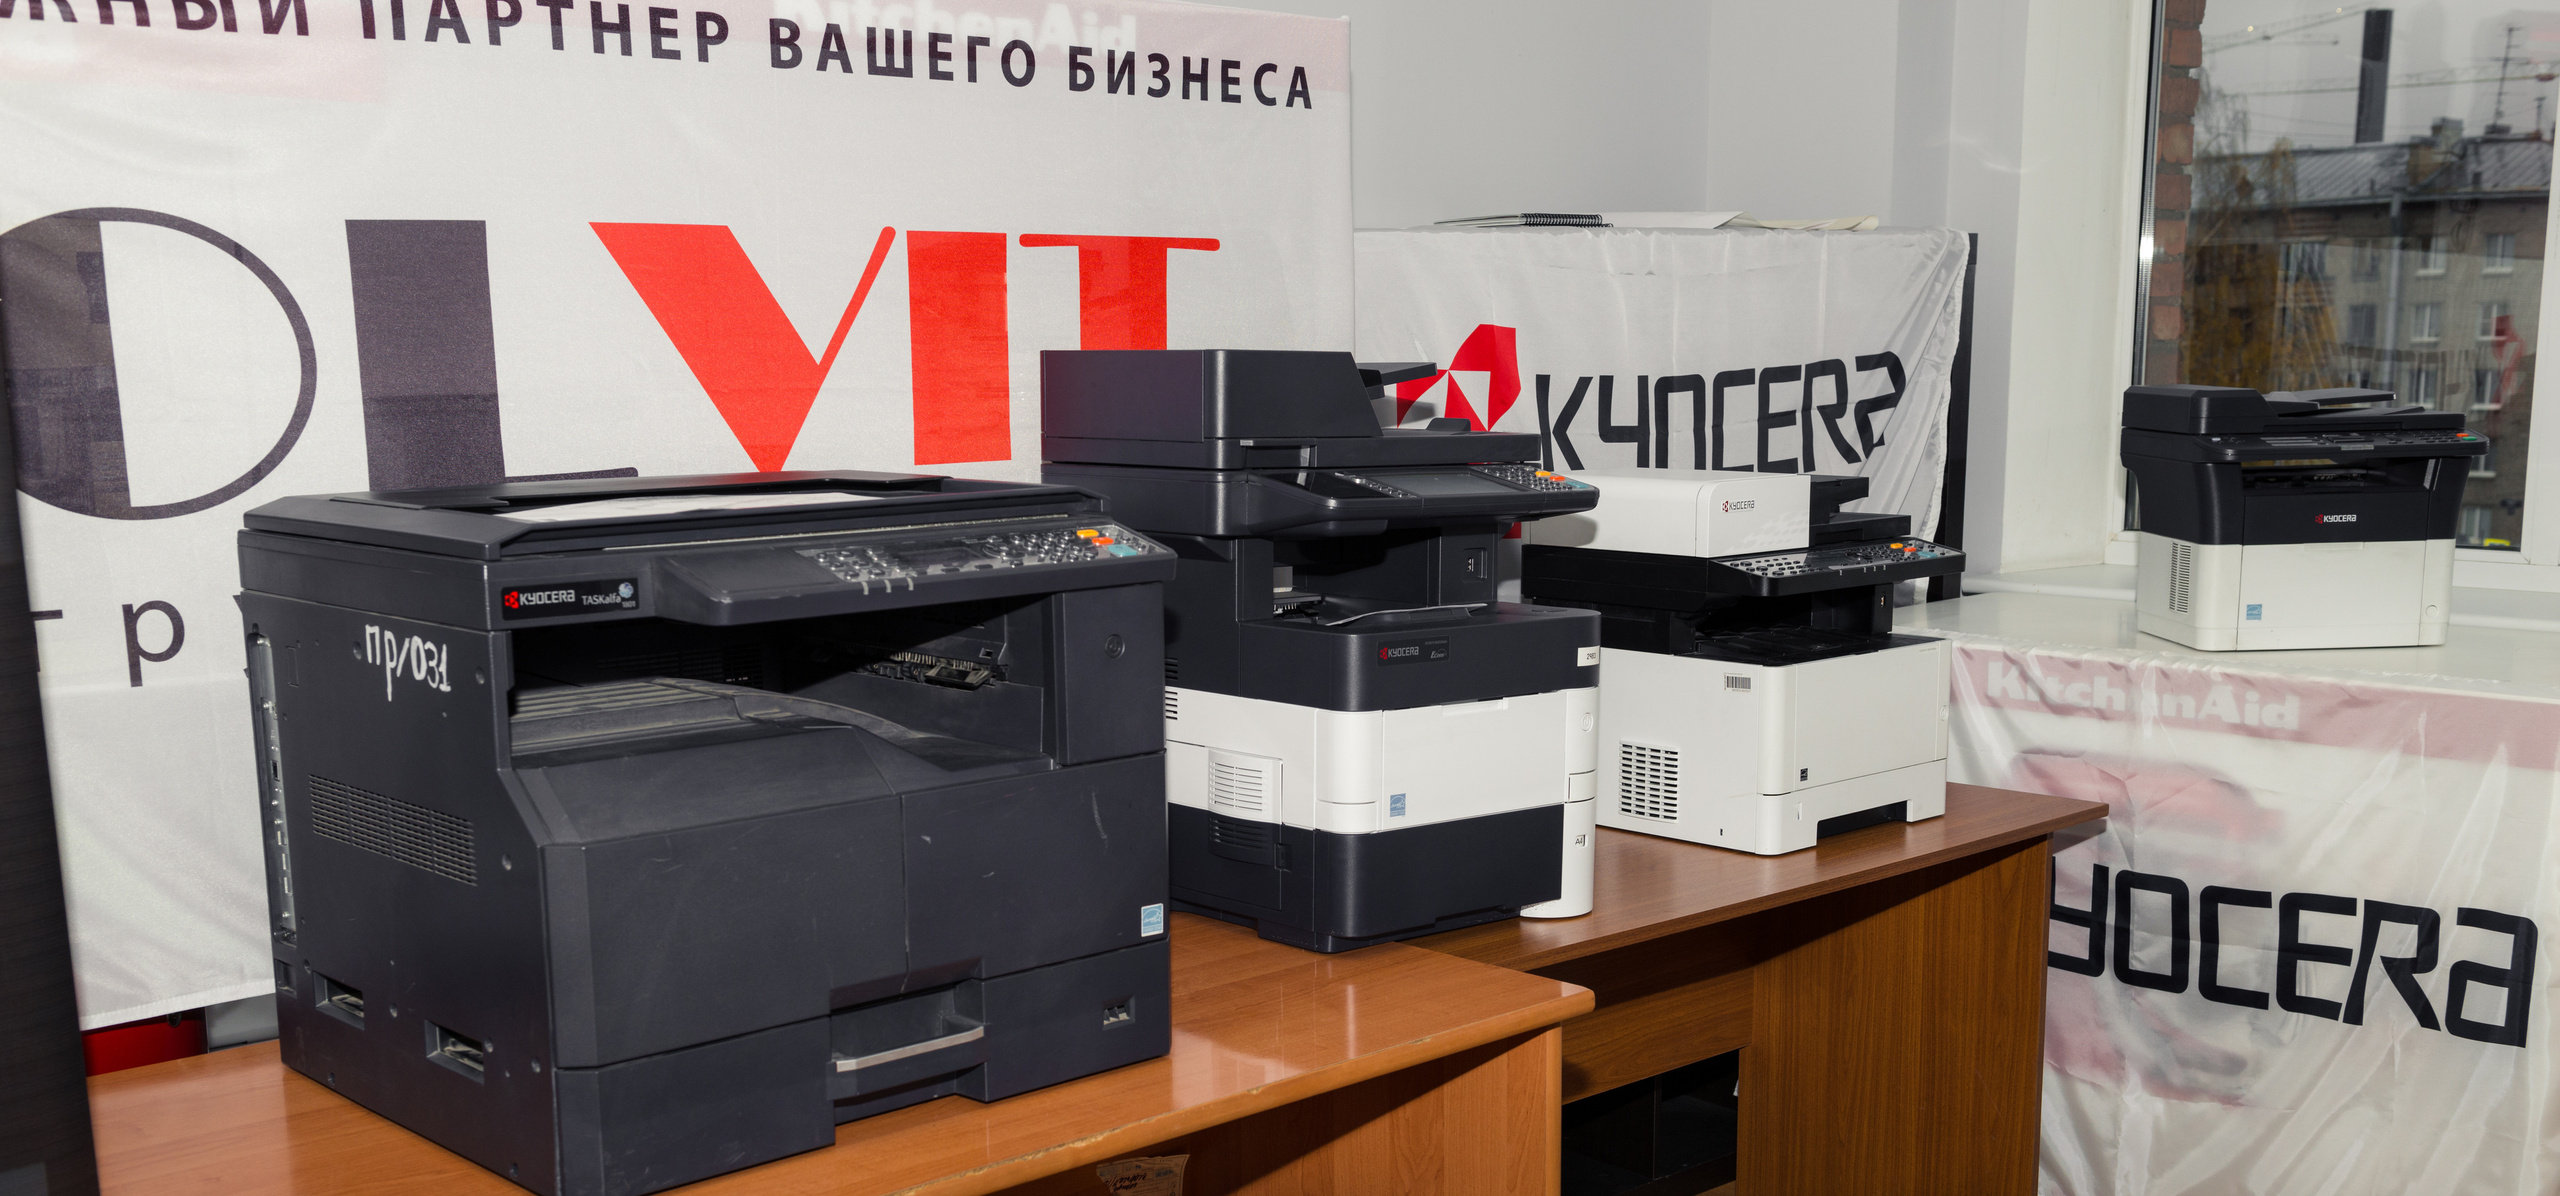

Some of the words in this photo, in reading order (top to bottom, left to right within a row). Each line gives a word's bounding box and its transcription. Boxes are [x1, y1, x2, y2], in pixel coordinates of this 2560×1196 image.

[360, 0, 729, 62] ПАРТНЕР
[769, 17, 1036, 88] ВАШЕГО
[1069, 46, 1313, 109] БИЗНЕСА
[1535, 351, 1907, 474] KYOCERA
[1729, 500, 1755, 510] KYOCERA
[2323, 514, 2357, 523] KYOCERA
[519, 589, 576, 606] KYOCERA
[581, 592, 622, 606] TASKalfa
[1388, 646, 1419, 658] KYOCERA
[1987, 661, 2300, 730] KtchnAid
